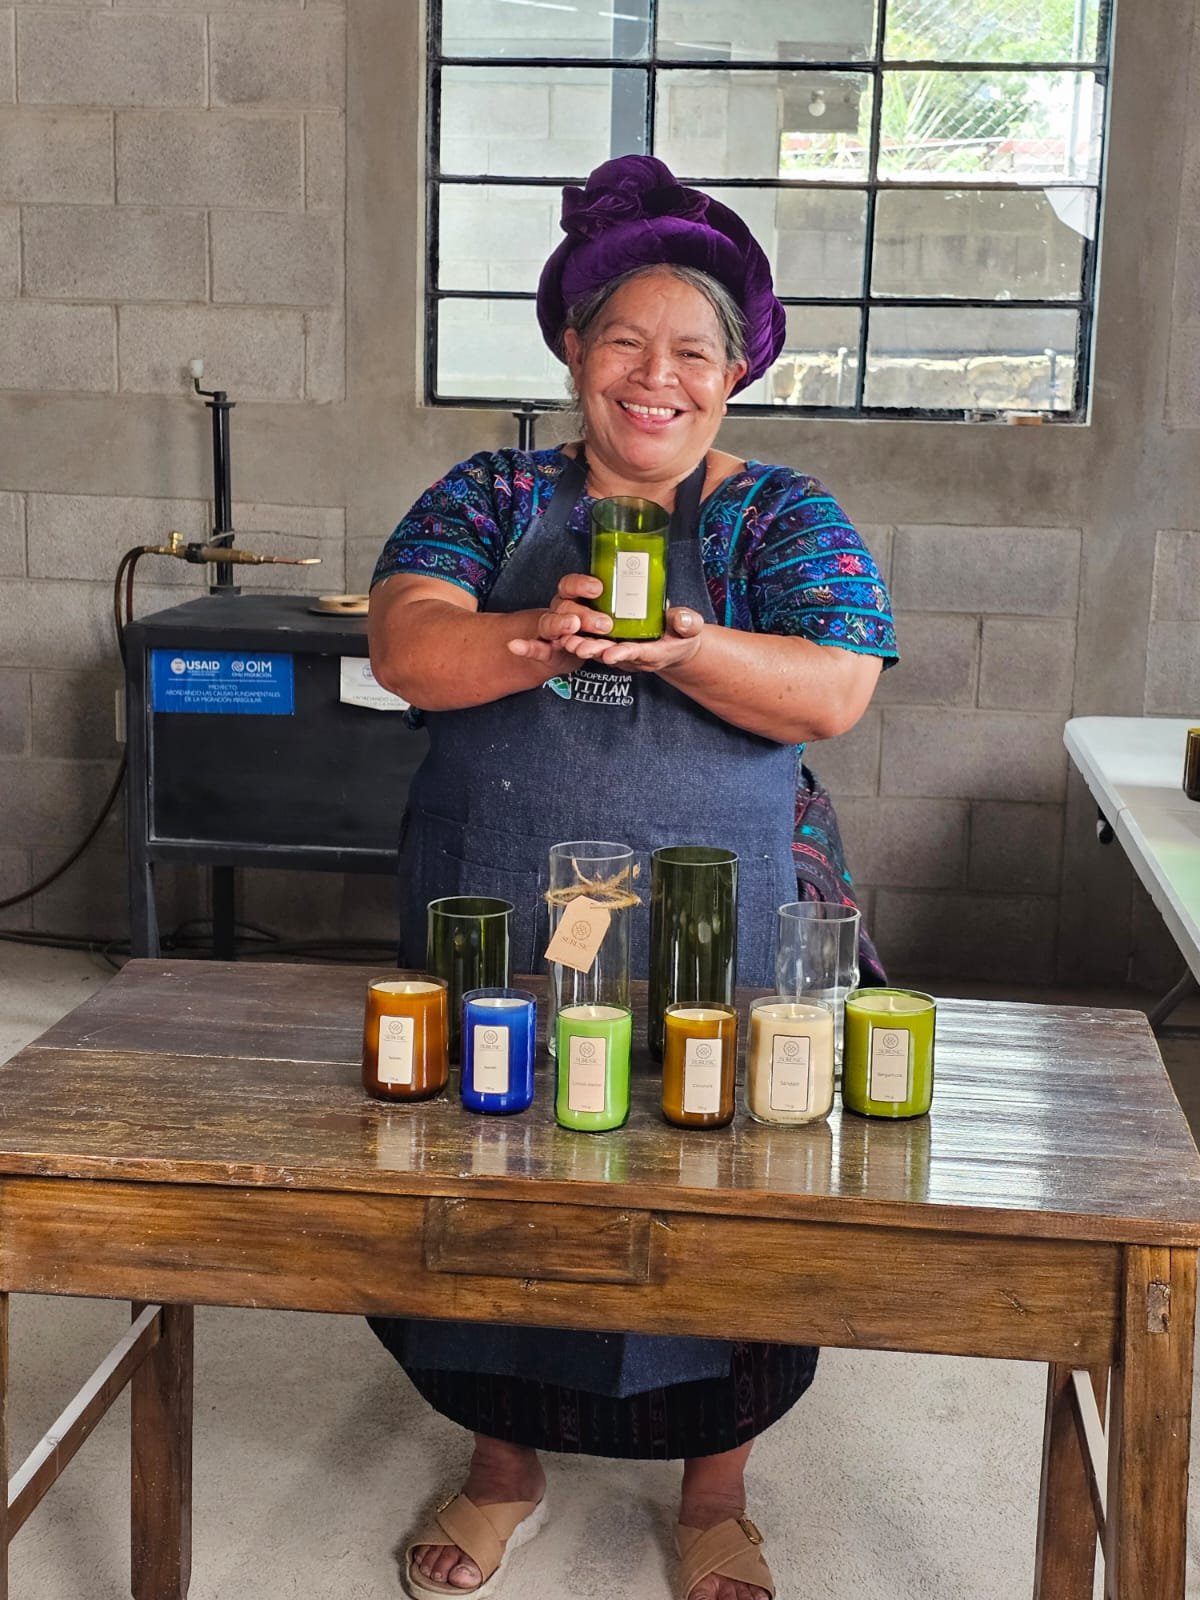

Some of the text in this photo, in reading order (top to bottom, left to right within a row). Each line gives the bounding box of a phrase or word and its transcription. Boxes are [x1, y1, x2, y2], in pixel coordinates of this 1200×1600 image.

[186, 660, 220, 670] USAID
[246, 661, 272, 672] OIM
[575, 670, 632, 682] COOPERATIVA
